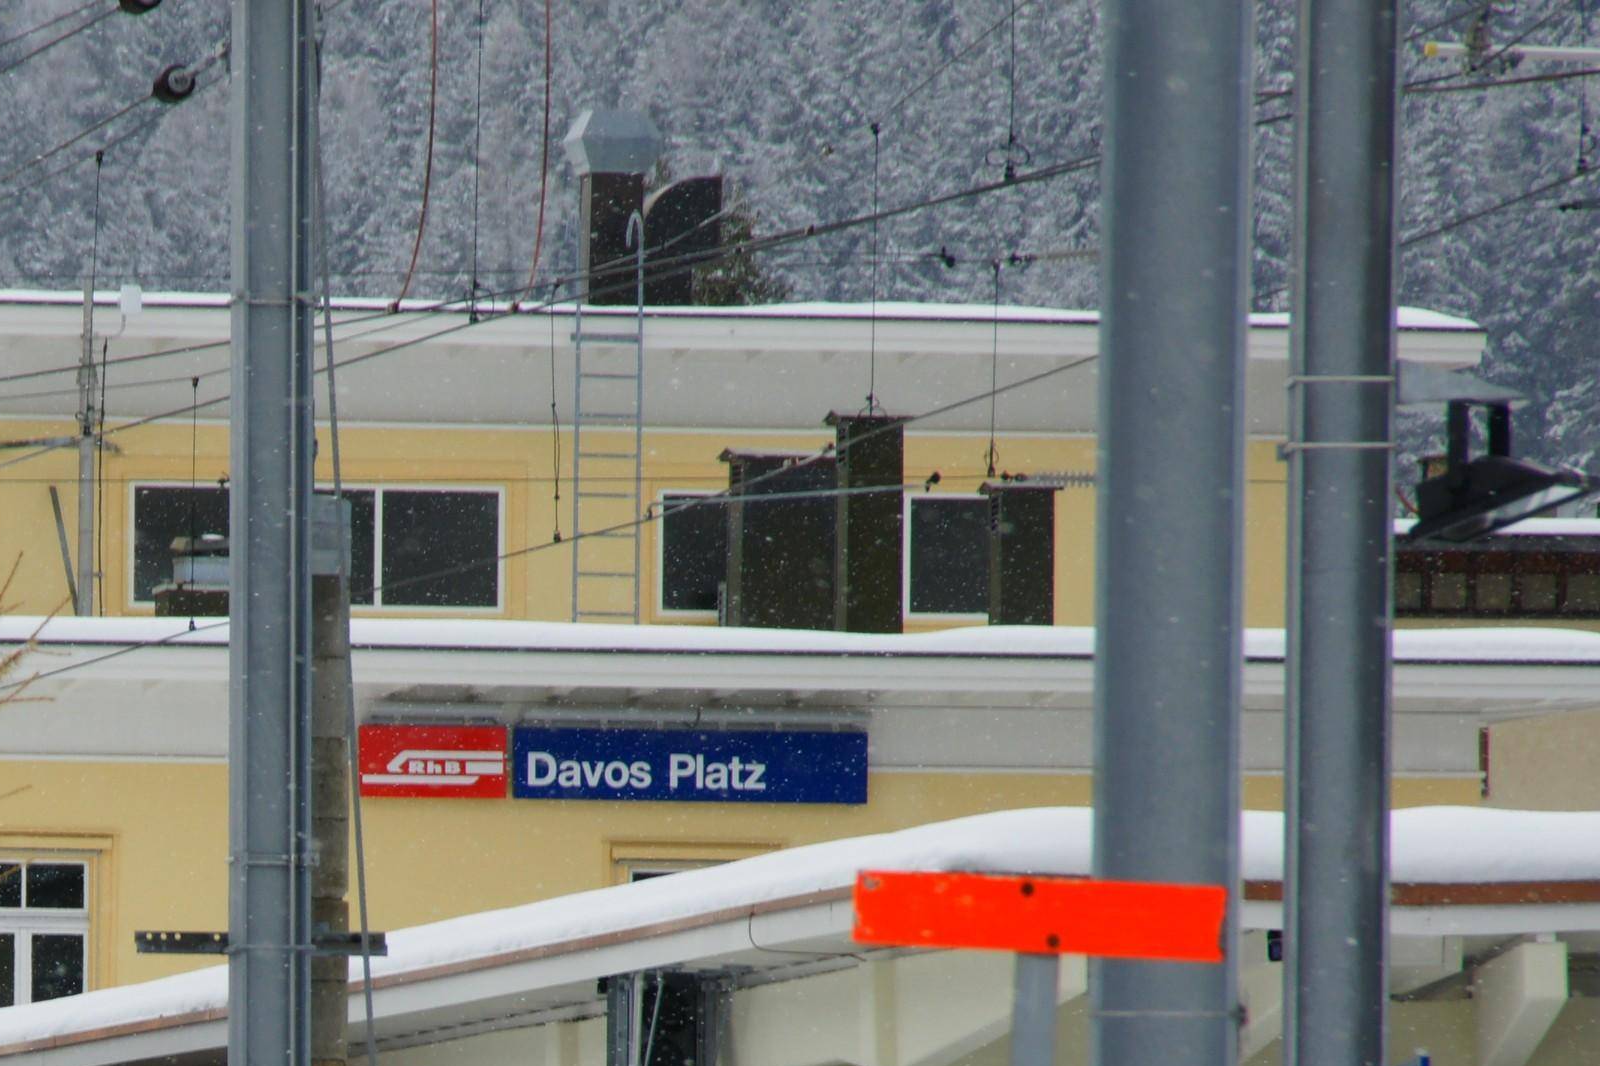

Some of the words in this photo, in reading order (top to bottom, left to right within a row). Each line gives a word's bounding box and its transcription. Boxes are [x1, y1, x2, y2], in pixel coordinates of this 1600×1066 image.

[408, 760, 461, 774] RhB
[527, 751, 652, 788] Davos
[669, 753, 766, 790] Platz
